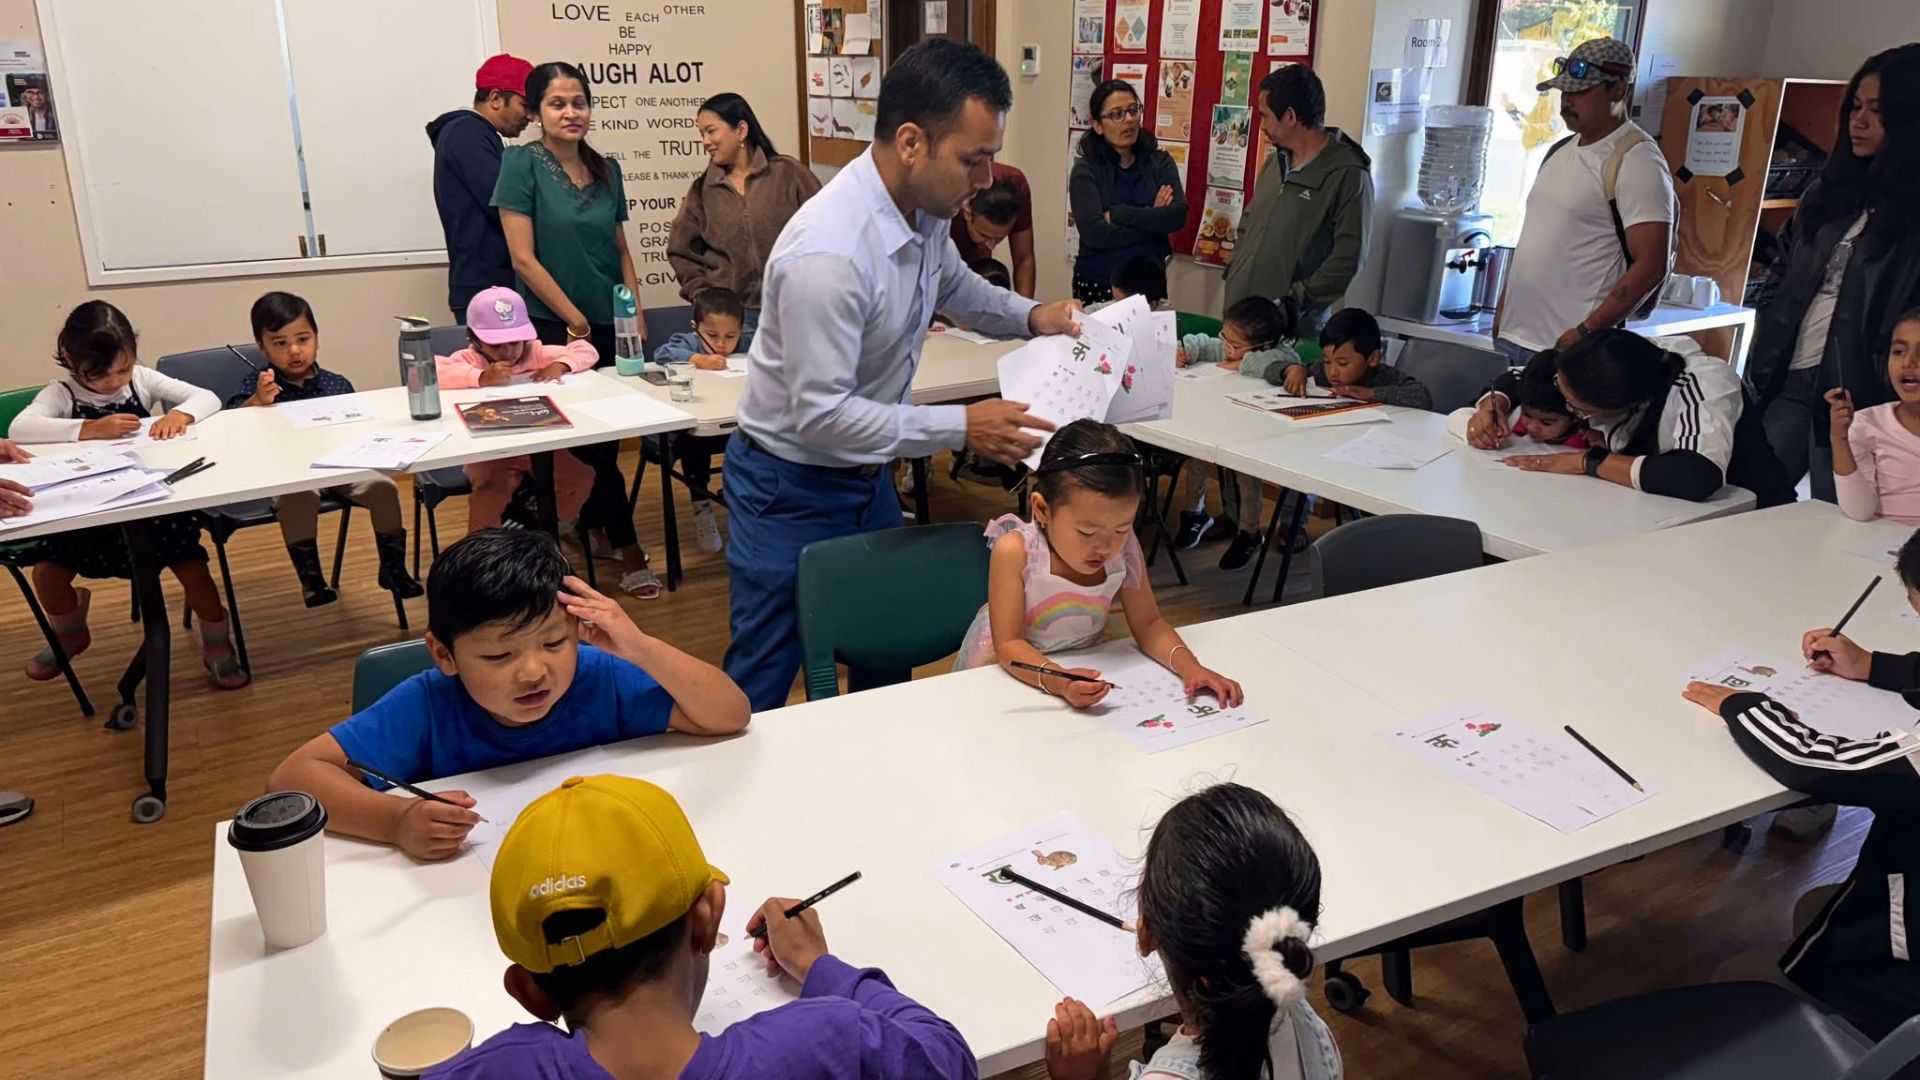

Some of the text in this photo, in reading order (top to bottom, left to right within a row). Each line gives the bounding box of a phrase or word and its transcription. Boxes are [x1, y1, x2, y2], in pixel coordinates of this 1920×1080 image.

[552, 3, 705, 23] LOVE EACH OTHER
[619, 26, 636, 38] BE
[608, 43, 652, 56] HAPPY
[577, 62, 703, 84] AUGH ALOT
[591, 95, 627, 108] PECT
[635, 97, 657, 107] ONE
[601, 119, 639, 130] KIND
[632, 150, 651, 160] THE
[623, 172, 651, 182] LEASE
[653, 173, 660, 181] &
[662, 172, 690, 180] THANK
[640, 197, 676, 210] YOUR
[1072, 341, 1091, 362] क
[529, 874, 587, 899] adidas
